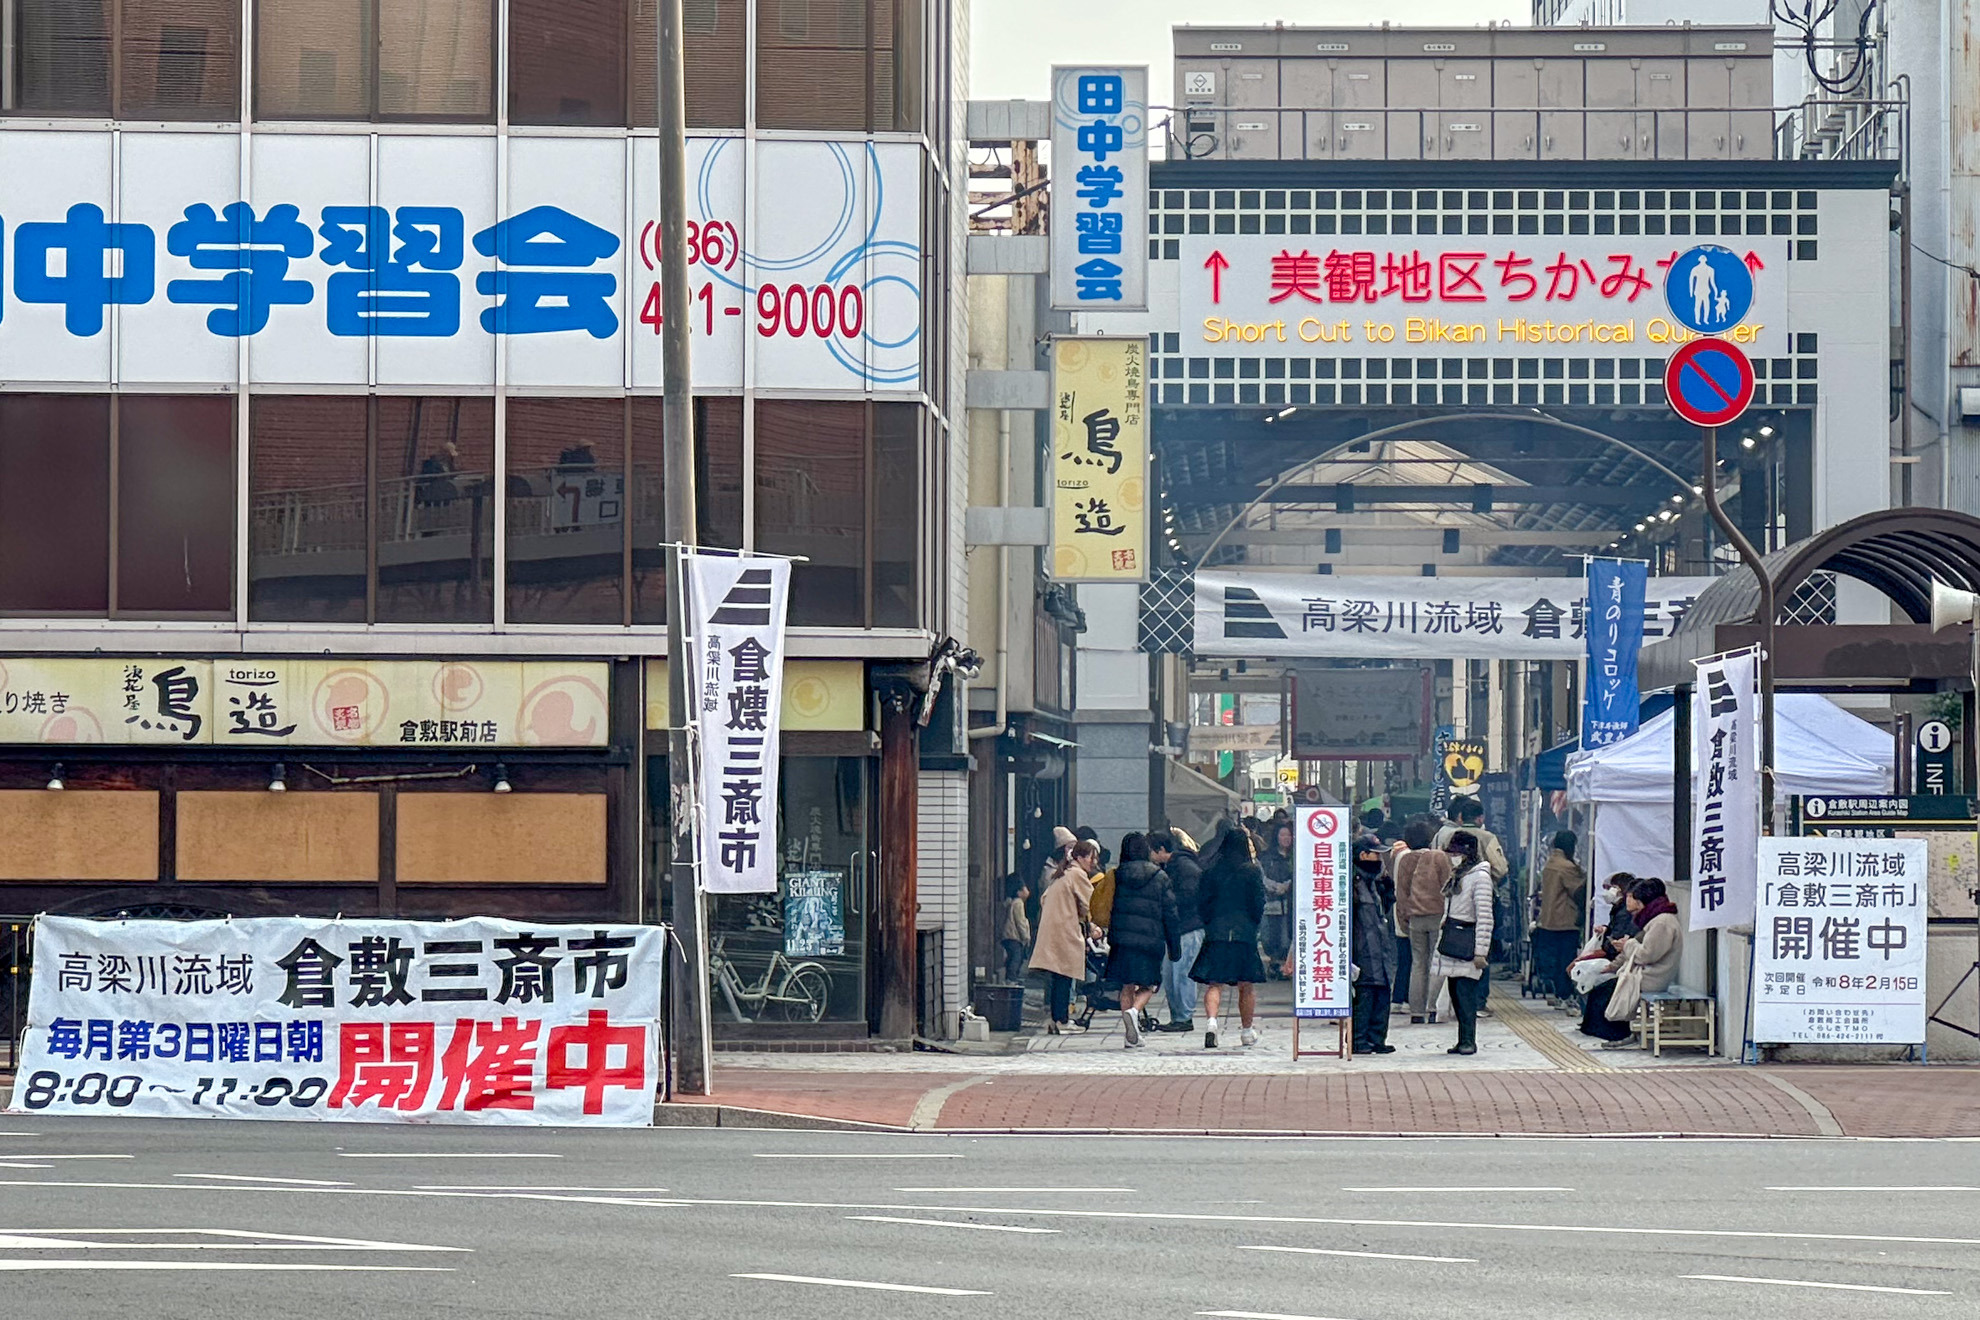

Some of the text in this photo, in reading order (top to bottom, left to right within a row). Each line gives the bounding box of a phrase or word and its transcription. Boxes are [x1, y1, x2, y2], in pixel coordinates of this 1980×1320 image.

[1075, 75, 1123, 301] 田中学習会
[640, 220, 739, 271] (36)
[0, 201, 620, 339] 中学習会
[1268, 249, 1679, 304] 美観地区ちかみ
[640, 281, 863, 339] 41-9000
[1204, 318, 1765, 344] Short Cut to Bikan Historical Quer
[1057, 479, 1089, 487] torizo
[1301, 598, 1503, 634] 高梁川流域
[1602, 575, 1625, 711] 青のりコロッケ
[229, 668, 276, 680] torizo
[0, 690, 70, 714] り焼き
[399, 719, 498, 743] 倉敷駅前店
[1698, 727, 1728, 912] 倉敷三斎市
[1828, 799, 1909, 810] 倉敷駅周辺案内図
[789, 878, 826, 888] GIANT
[1777, 851, 1906, 878] 高梁川流域
[1766, 882, 1917, 908] 「倉敷三斎市」
[1312, 842, 1334, 1001] 自転車乗り入れ禁止
[1772, 916, 1907, 960] 開催中
[57, 931, 637, 1009] 高梁川流域 倉敷三斎市
[1764, 972, 1805, 983] 次回開催
[1812, 974, 1918, 991] 令和8年2月15日
[46, 1017, 324, 1063] 毎月第3日曜日朝
[329, 1009, 646, 1115] 開催中
